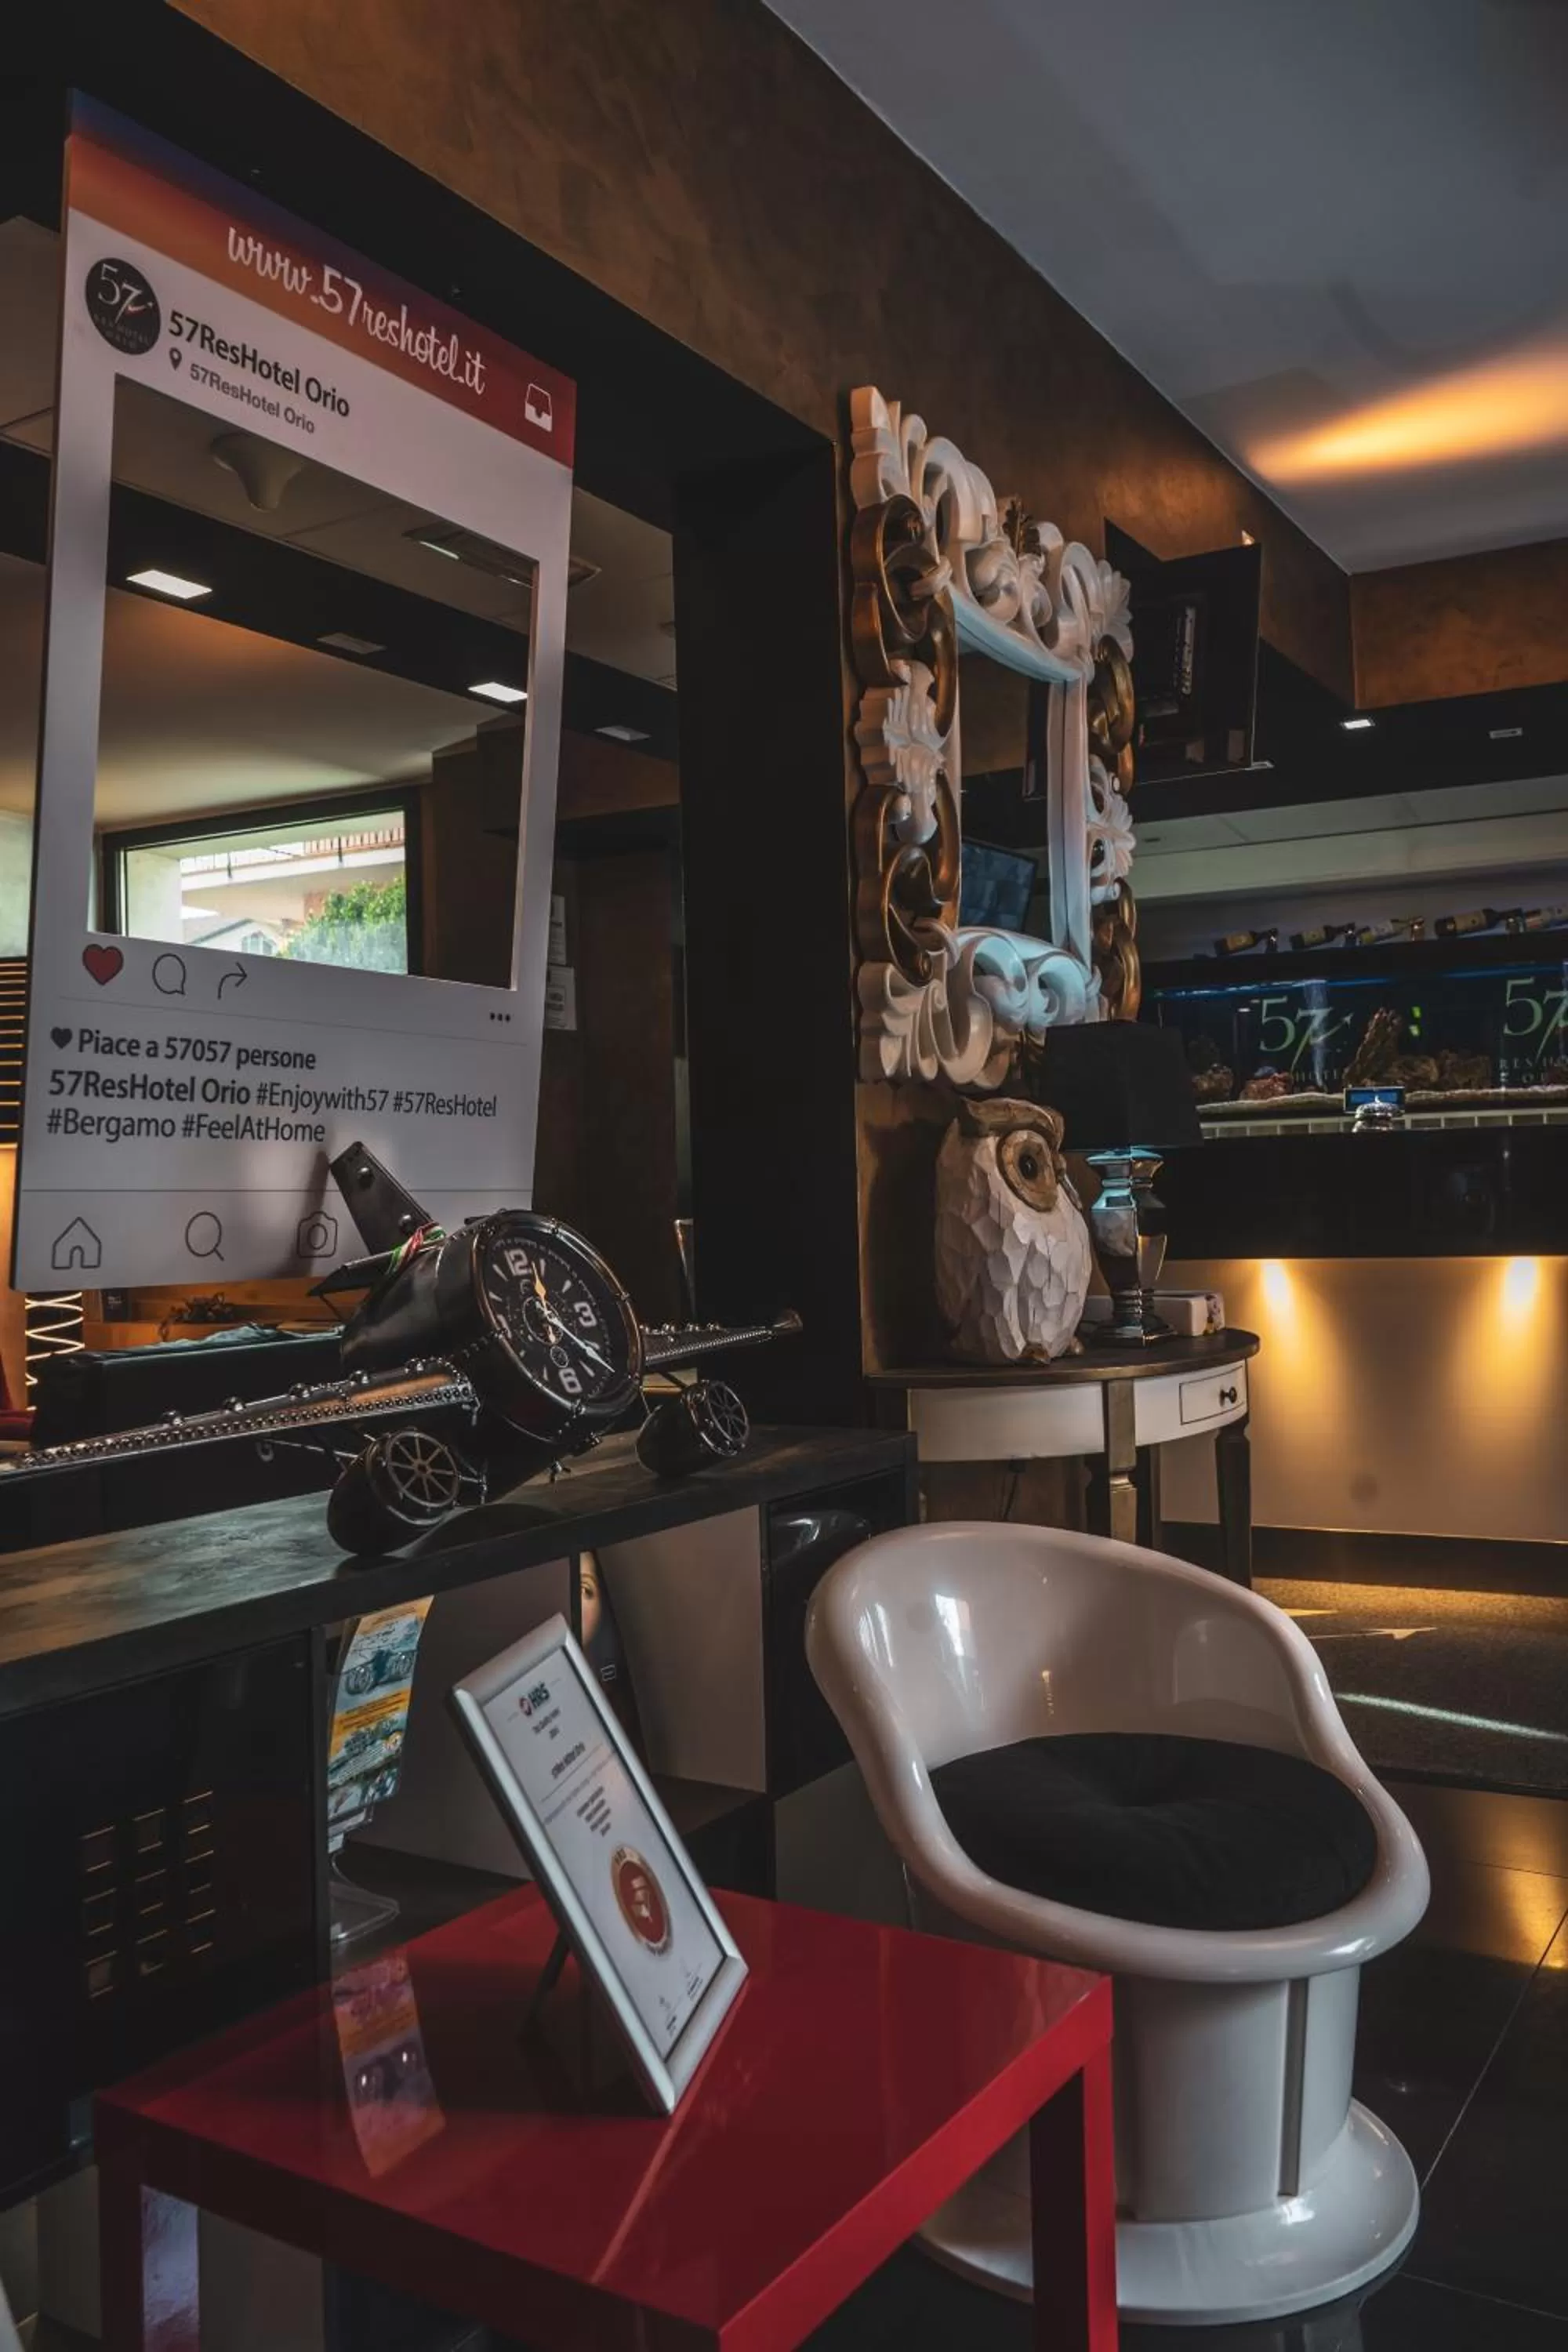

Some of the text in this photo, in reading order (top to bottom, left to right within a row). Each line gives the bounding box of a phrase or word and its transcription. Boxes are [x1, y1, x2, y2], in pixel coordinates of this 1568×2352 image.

[98, 263, 143, 324] 57
[227, 226, 486, 395] www.57reshotel.it
[169, 310, 300, 394] 57ResHotel
[305, 376, 350, 417] Orio
[190, 363, 315, 434] 57ResHotel Orio
[78, 1028, 317, 1070] Piace a 57057 persone
[1258, 995, 1334, 1073] 57
[49, 1069, 497, 1117] 57ResHotel Orio #Enjoywith57 #57ResHotel
[46, 1107, 325, 1143] #Bergamo #FeelAtHome
[573, 1301, 597, 1327] 3
[558, 1368, 583, 1395] 6
